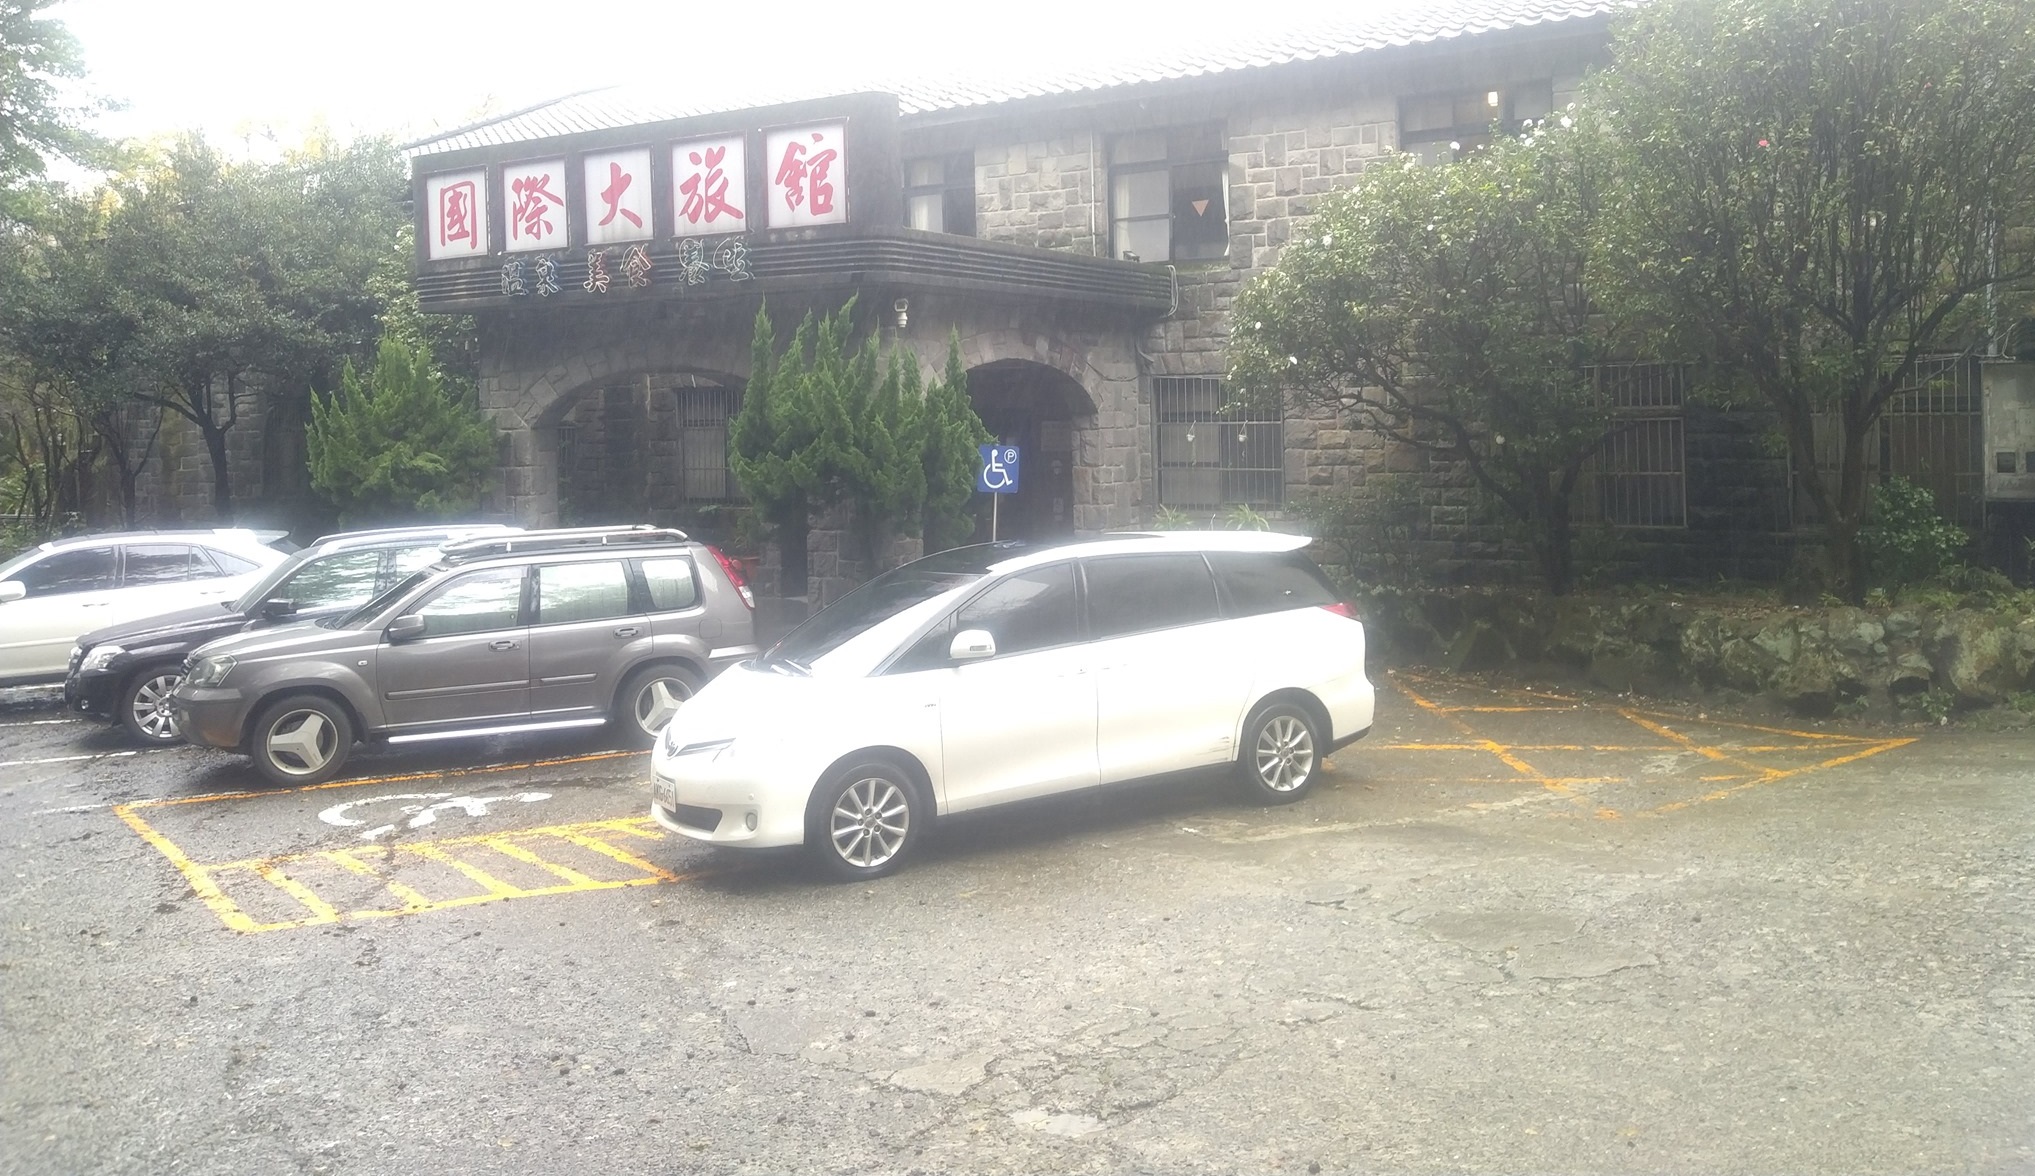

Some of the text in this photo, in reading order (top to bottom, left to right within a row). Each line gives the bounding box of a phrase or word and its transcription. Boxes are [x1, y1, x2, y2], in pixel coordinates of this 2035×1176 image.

[440, 133, 837, 250] 國際大旅館
[583, 244, 652, 293] 美食
